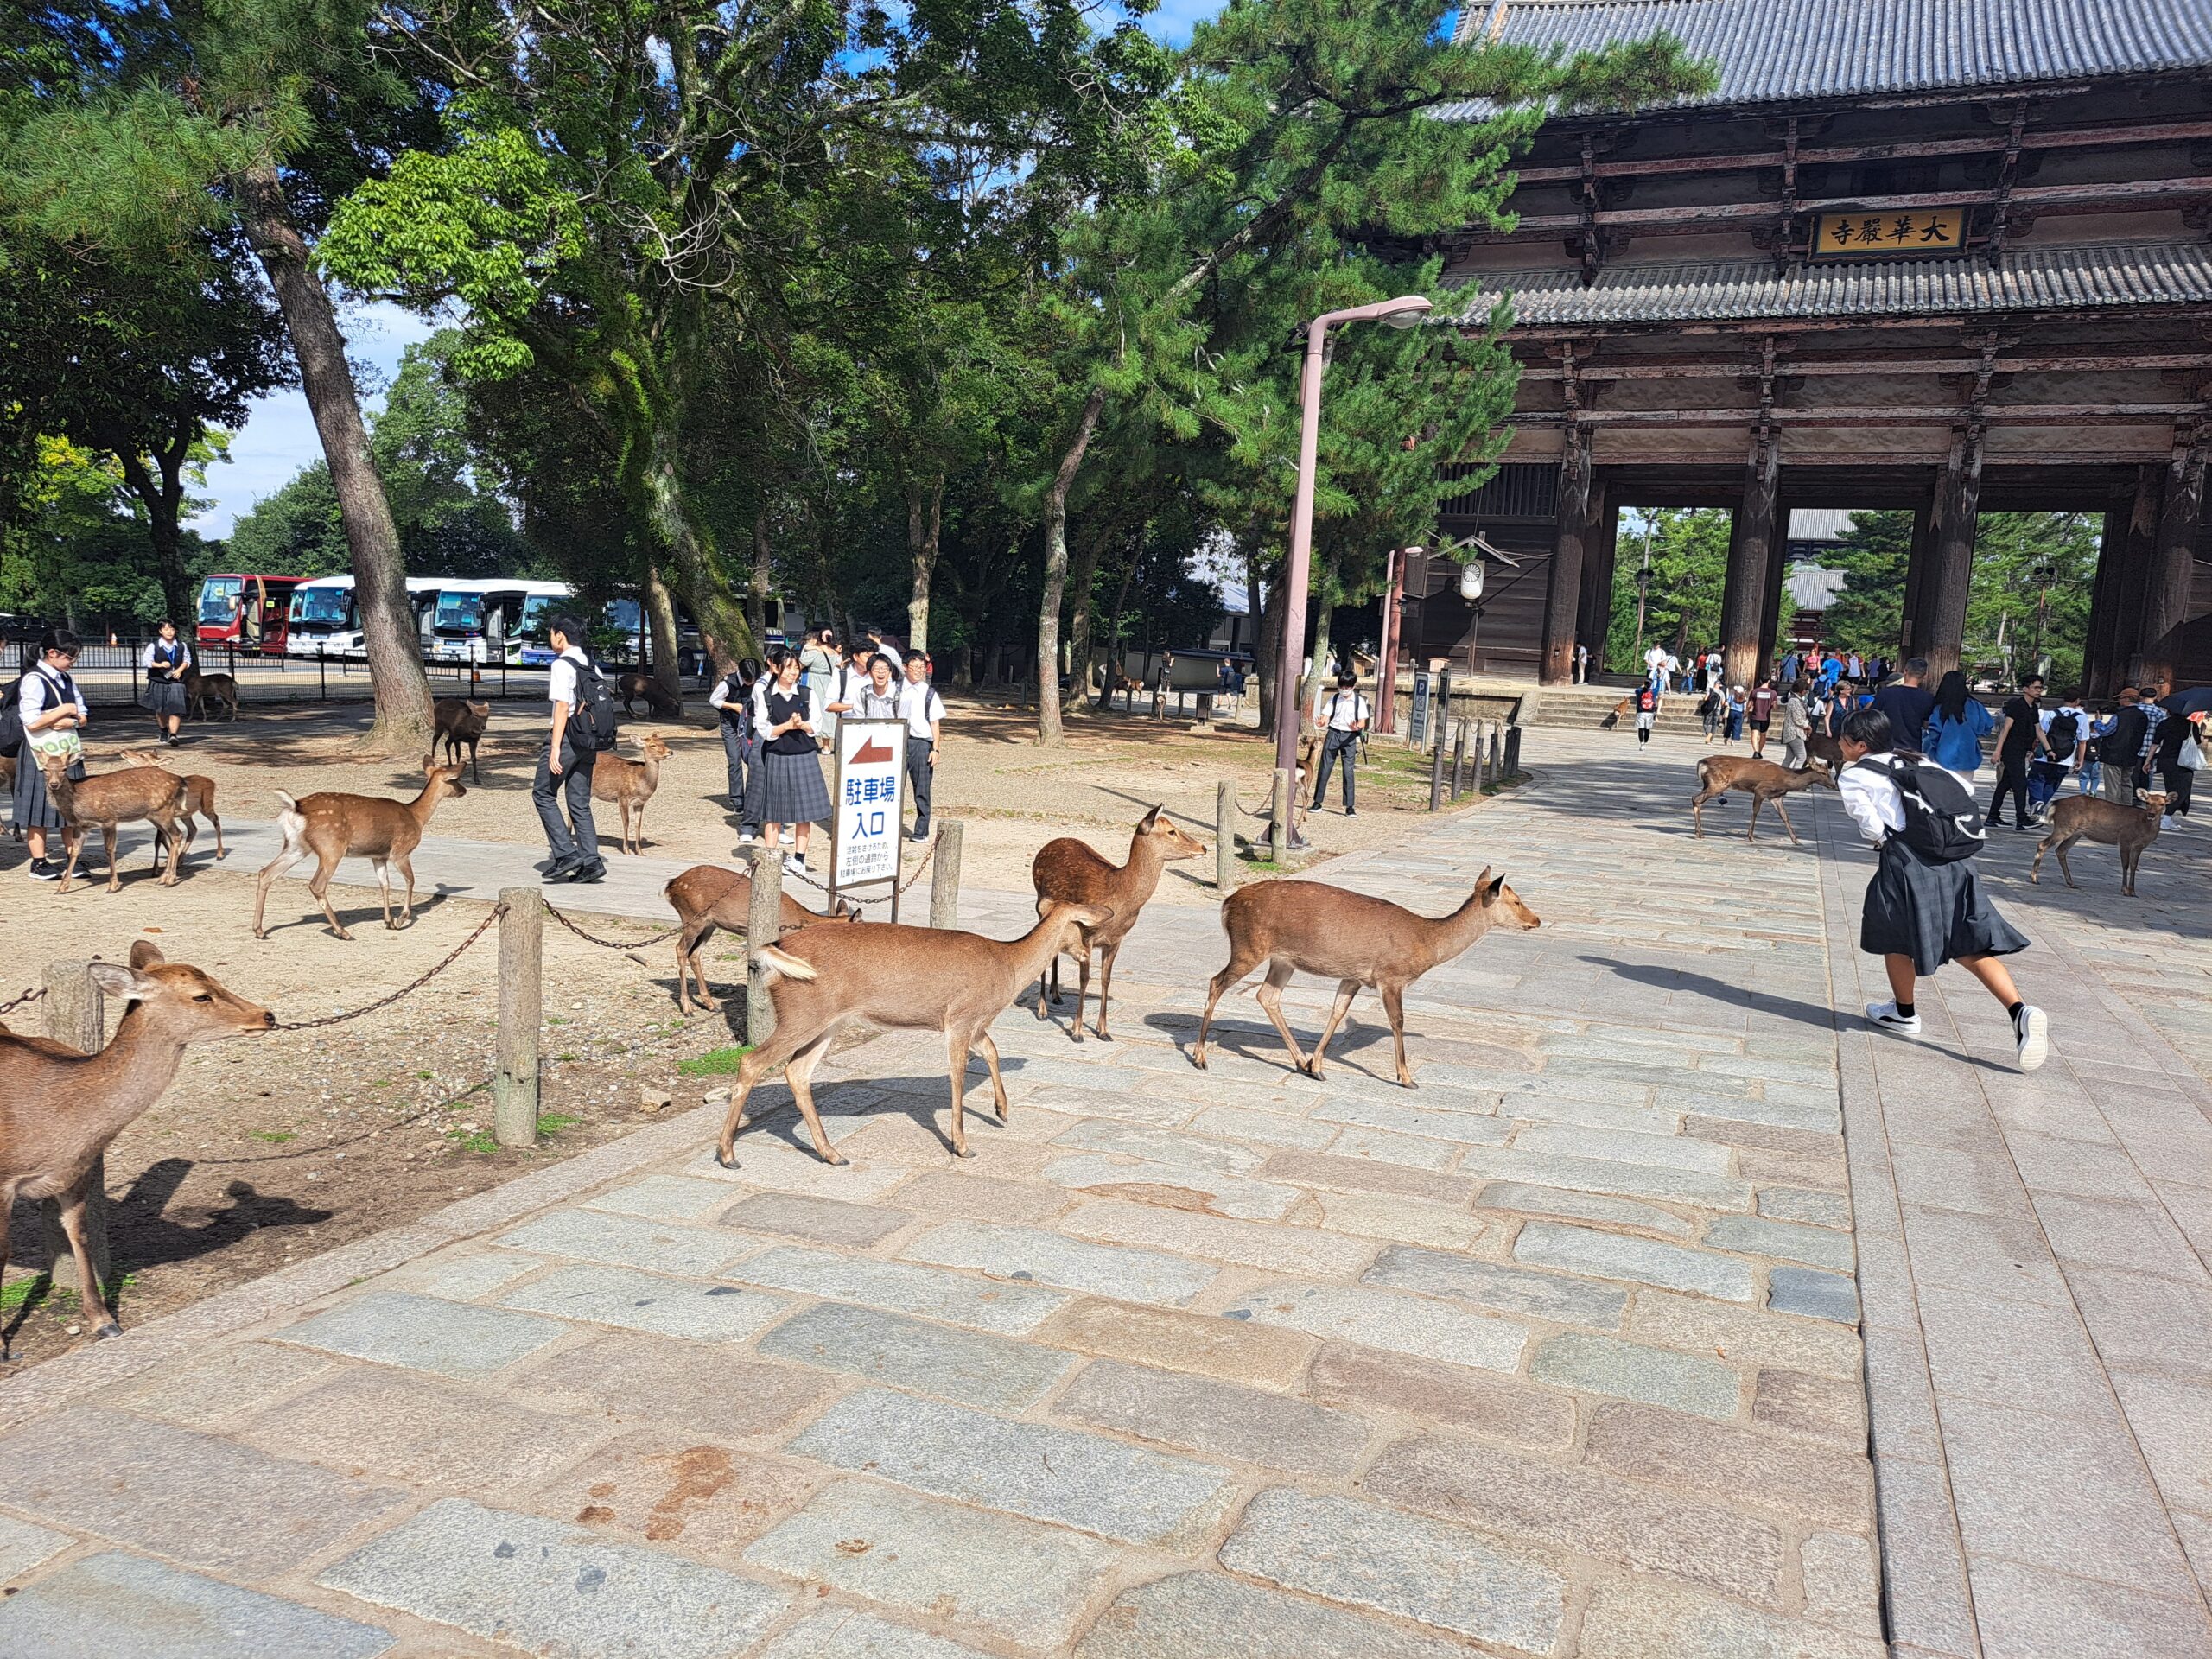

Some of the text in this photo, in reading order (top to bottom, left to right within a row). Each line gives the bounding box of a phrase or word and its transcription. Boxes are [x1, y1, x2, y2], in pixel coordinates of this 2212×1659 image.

[1419, 683, 1425, 694] P
[845, 776, 895, 806] 駐車場
[852, 811, 884, 840] 入口
